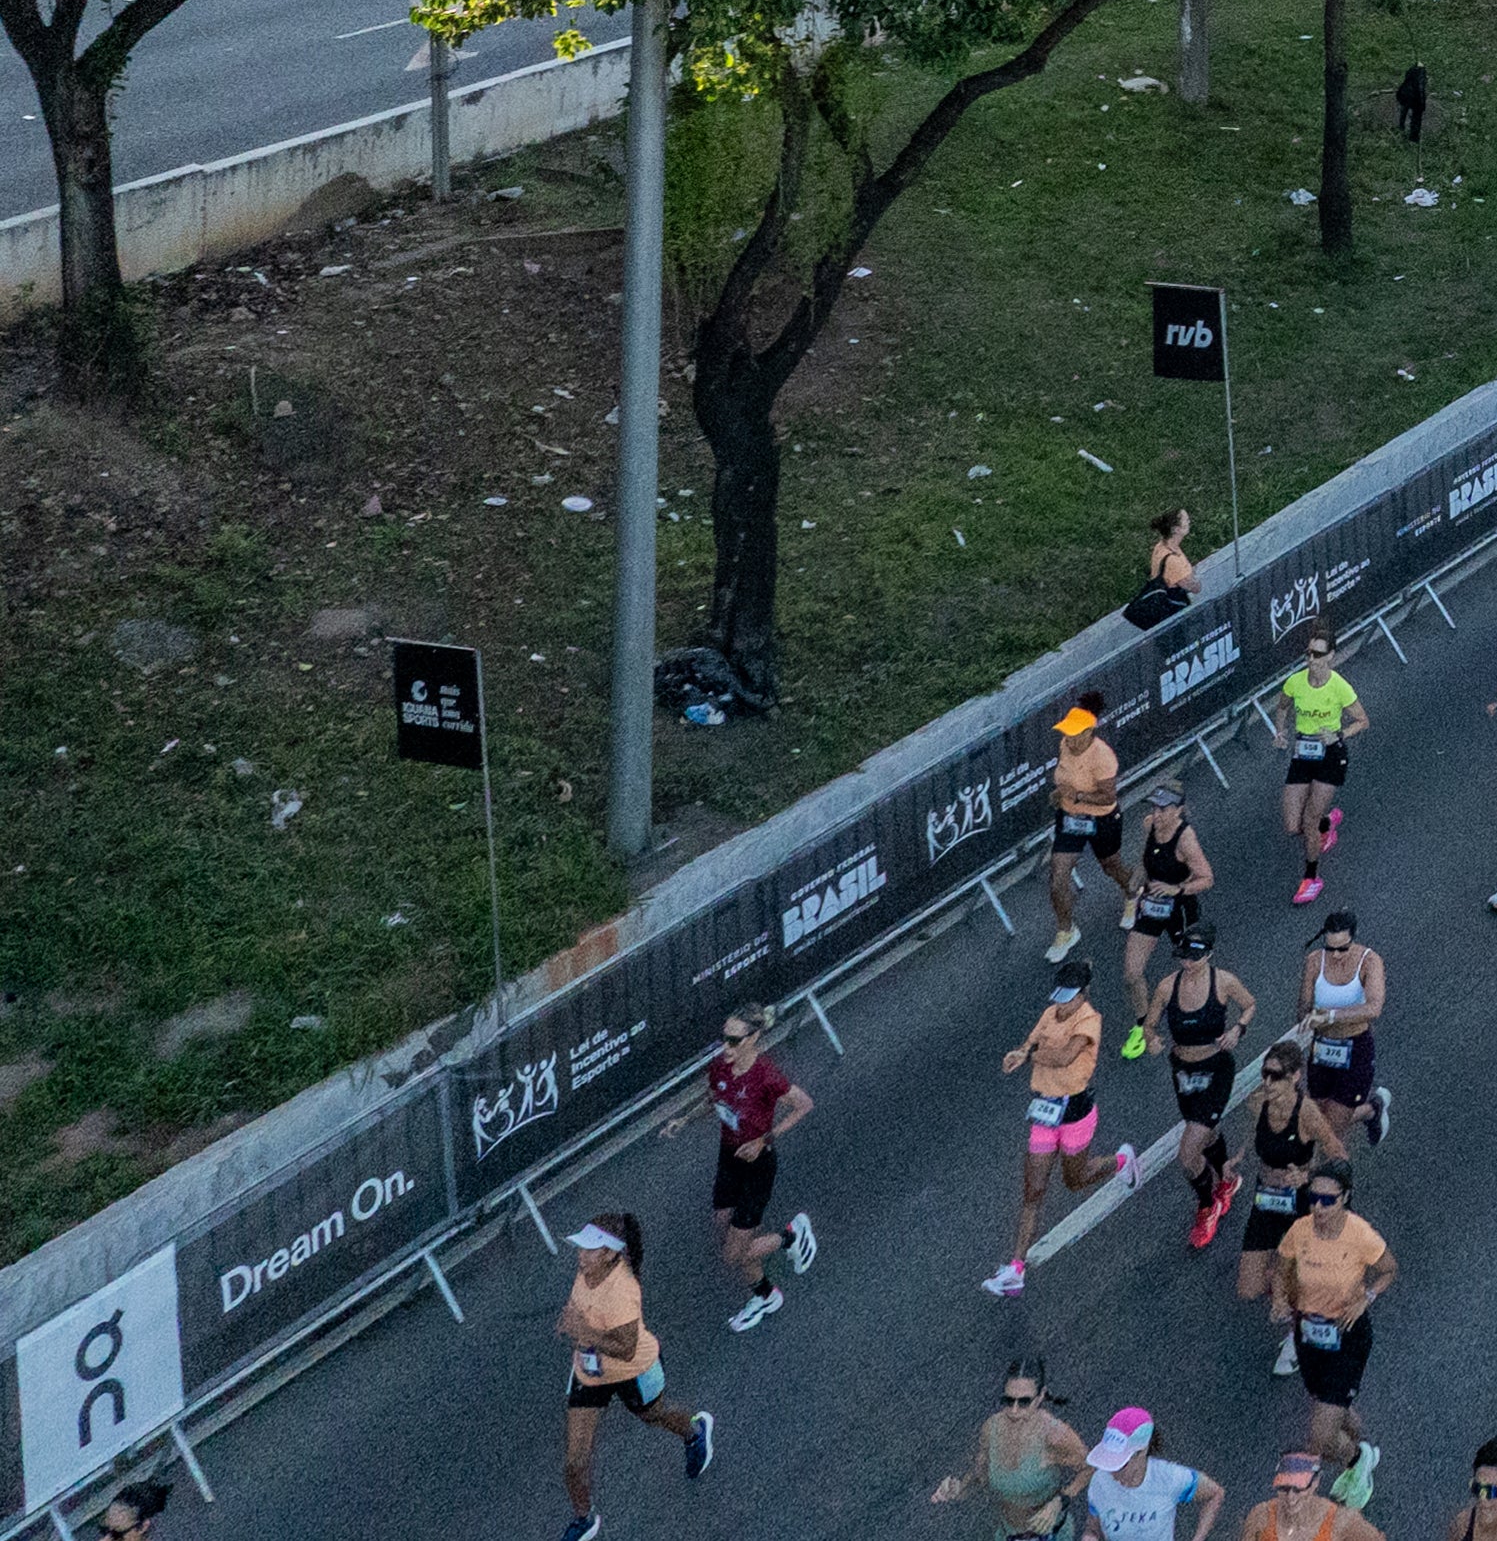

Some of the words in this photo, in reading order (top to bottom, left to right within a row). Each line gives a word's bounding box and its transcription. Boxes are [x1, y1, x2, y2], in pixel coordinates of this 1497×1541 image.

[1165, 319, 1214, 350] rvb
[1160, 632, 1241, 706] BRASIL
[402, 712, 440, 728] SPORTS
[782, 855, 887, 948] BRASIL
[570, 1037, 590, 1060] Lei
[592, 1028, 608, 1046] de
[571, 1032, 629, 1075] Incentivo
[629, 1019, 647, 1037] ao
[572, 1053, 621, 1090] Esporte
[220, 1211, 345, 1314] Dream
[350, 1168, 416, 1221] On.
